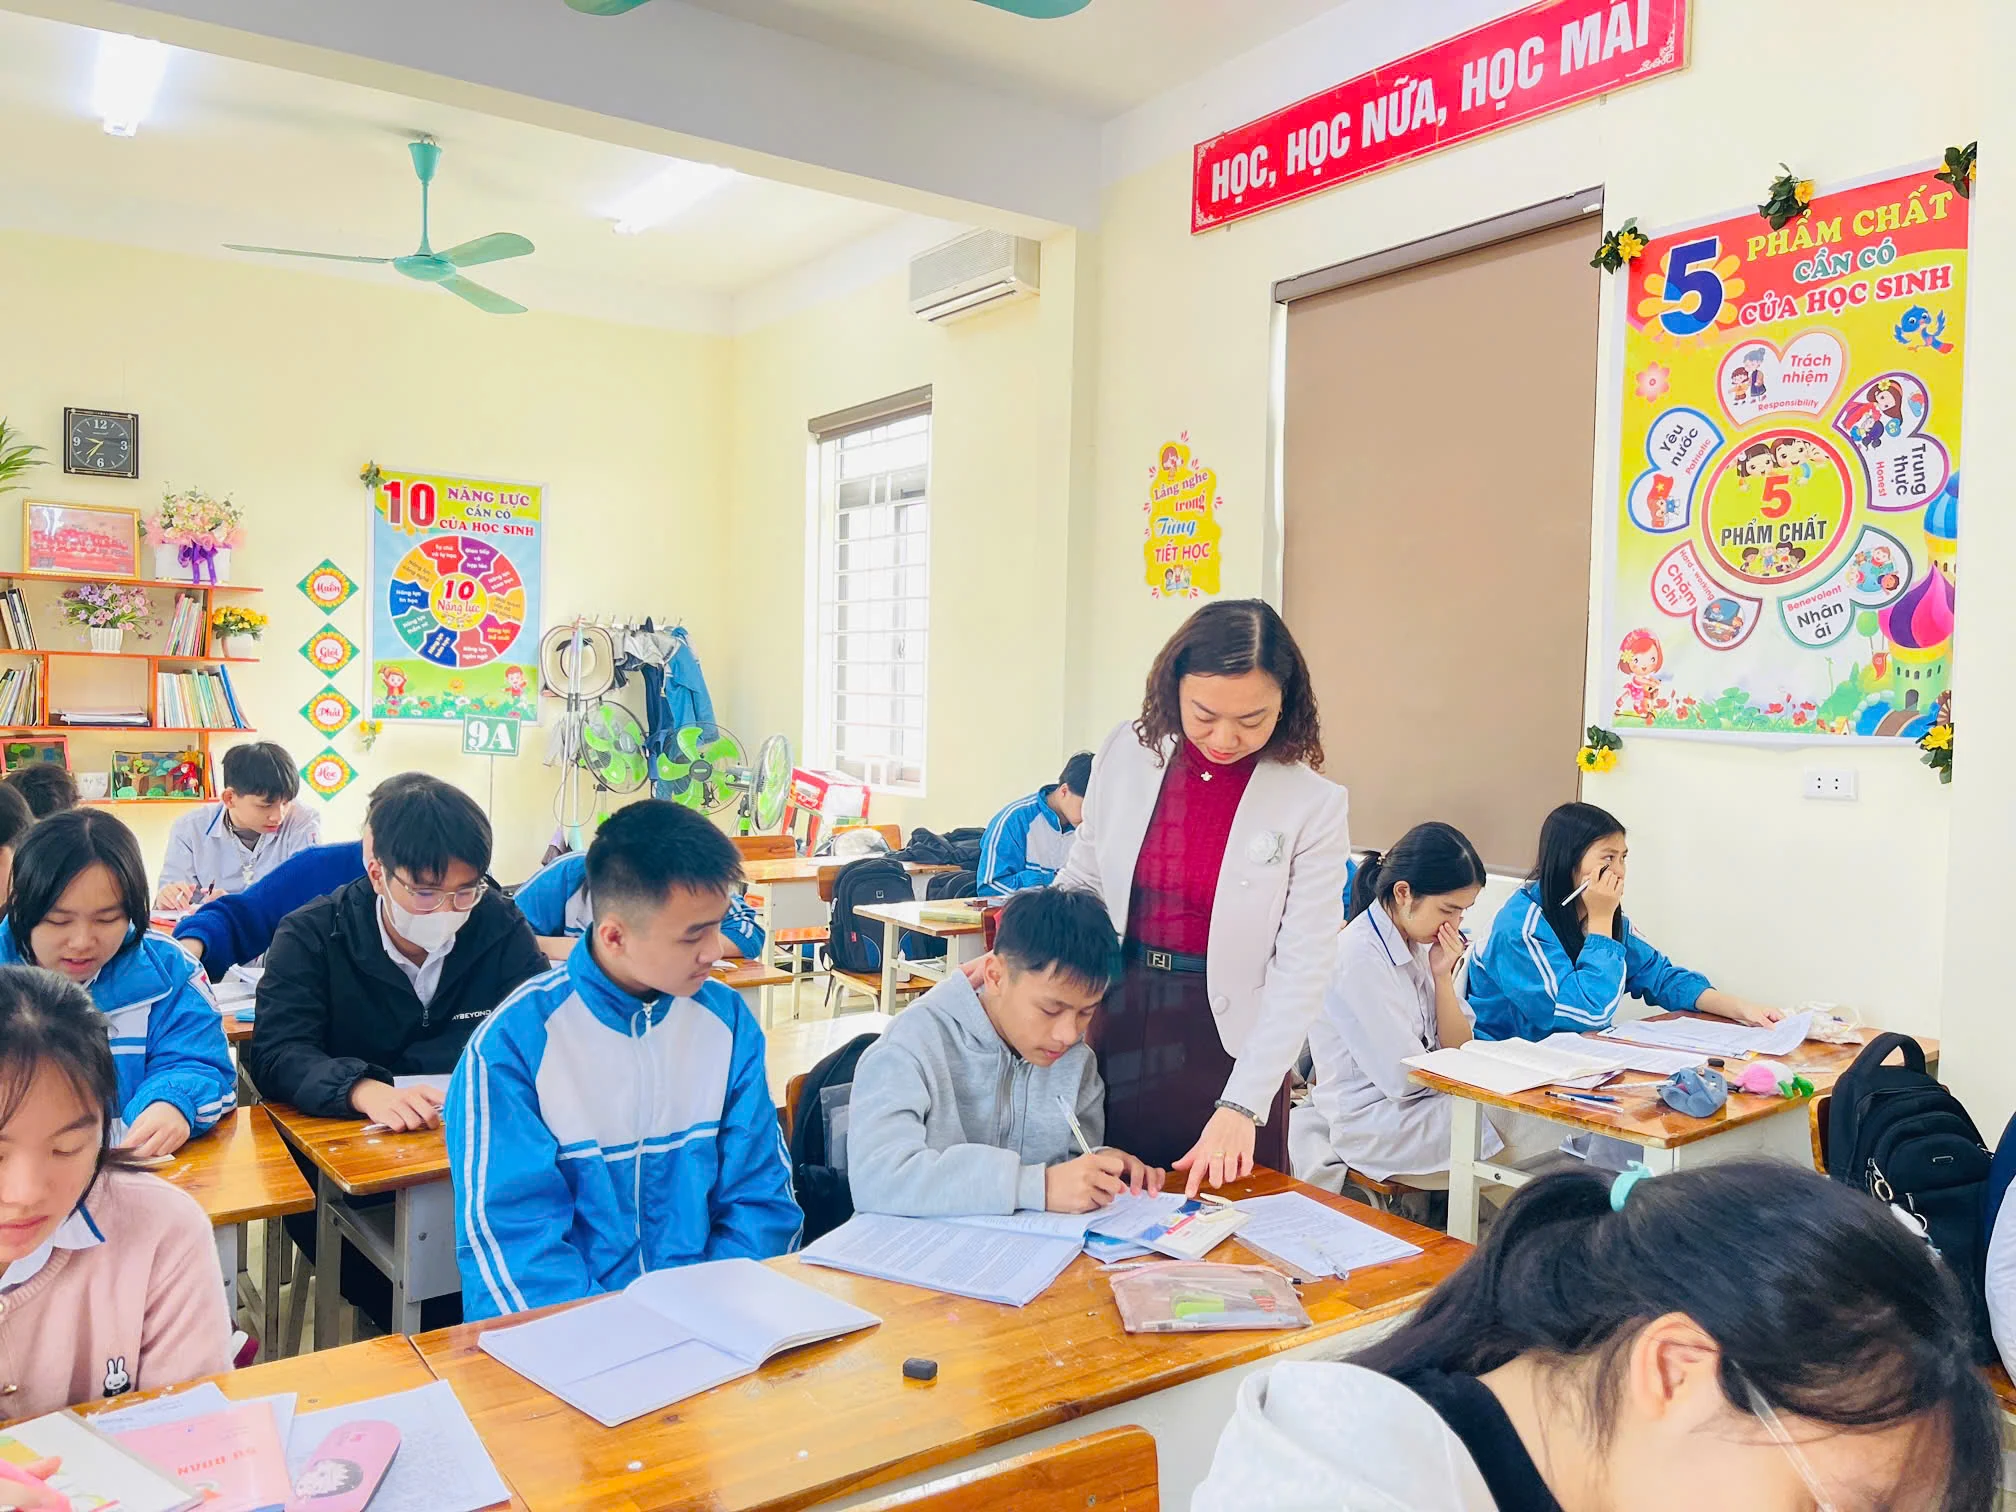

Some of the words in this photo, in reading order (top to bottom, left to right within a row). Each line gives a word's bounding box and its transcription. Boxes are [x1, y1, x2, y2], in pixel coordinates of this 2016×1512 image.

[1211, 145, 1277, 203] HỌC,
[1287, 112, 1351, 176] HỌC
[1361, 76, 1447, 149] NỮA,
[1462, 36, 1545, 114] HỌC
[1746, 209, 1842, 261] PHẨM
[1853, 185, 1953, 235] CHẤT
[1793, 248, 1851, 282] CẦN
[1858, 239, 1896, 271] CÓ
[1660, 237, 1723, 336] 5
[1740, 292, 1798, 326] CỦA
[1807, 282, 1867, 318] HỌC
[1875, 265, 1952, 300] SINH
[1791, 351, 1832, 367] Trách
[1782, 370, 1829, 386] nhiệm
[1758, 399, 1819, 412] Responsibility
[94, 419, 108, 430] 12
[1659, 424, 1684, 453] Yêu
[73, 436, 81, 447] 9
[120, 440, 128, 451] 3
[1670, 427, 1699, 467] nước
[1685, 438, 1711, 475] Patriotic
[96, 457, 105, 468] 6
[1891, 455, 1909, 496] thực
[1911, 443, 1927, 496] Trung
[1182, 472, 1208, 489] nghe
[1875, 461, 1887, 497] Honest
[383, 481, 435, 527] 10
[447, 486, 494, 503] NĂNG
[500, 492, 530, 509] LỰC
[1175, 493, 1206, 512] trong
[1760, 475, 1792, 518] 5
[439, 515, 467, 531] CỦA
[472, 521, 499, 535] HỌC
[503, 524, 534, 537] SINH
[1721, 518, 1773, 546] PHẨM
[1779, 517, 1827, 542] CHẤT
[1155, 539, 1178, 562] TIẾT
[1182, 542, 1210, 562] HỌC
[1667, 563, 1697, 607] Chăm
[1679, 549, 1693, 570] Hard
[1694, 572, 1716, 601] working
[445, 580, 475, 600] 10
[1661, 583, 1679, 606] chỉ
[1787, 585, 1842, 612] Benevolent
[1797, 601, 1844, 628] Nhân
[1814, 622, 1832, 639] ái
[468, 721, 514, 750] 9A
